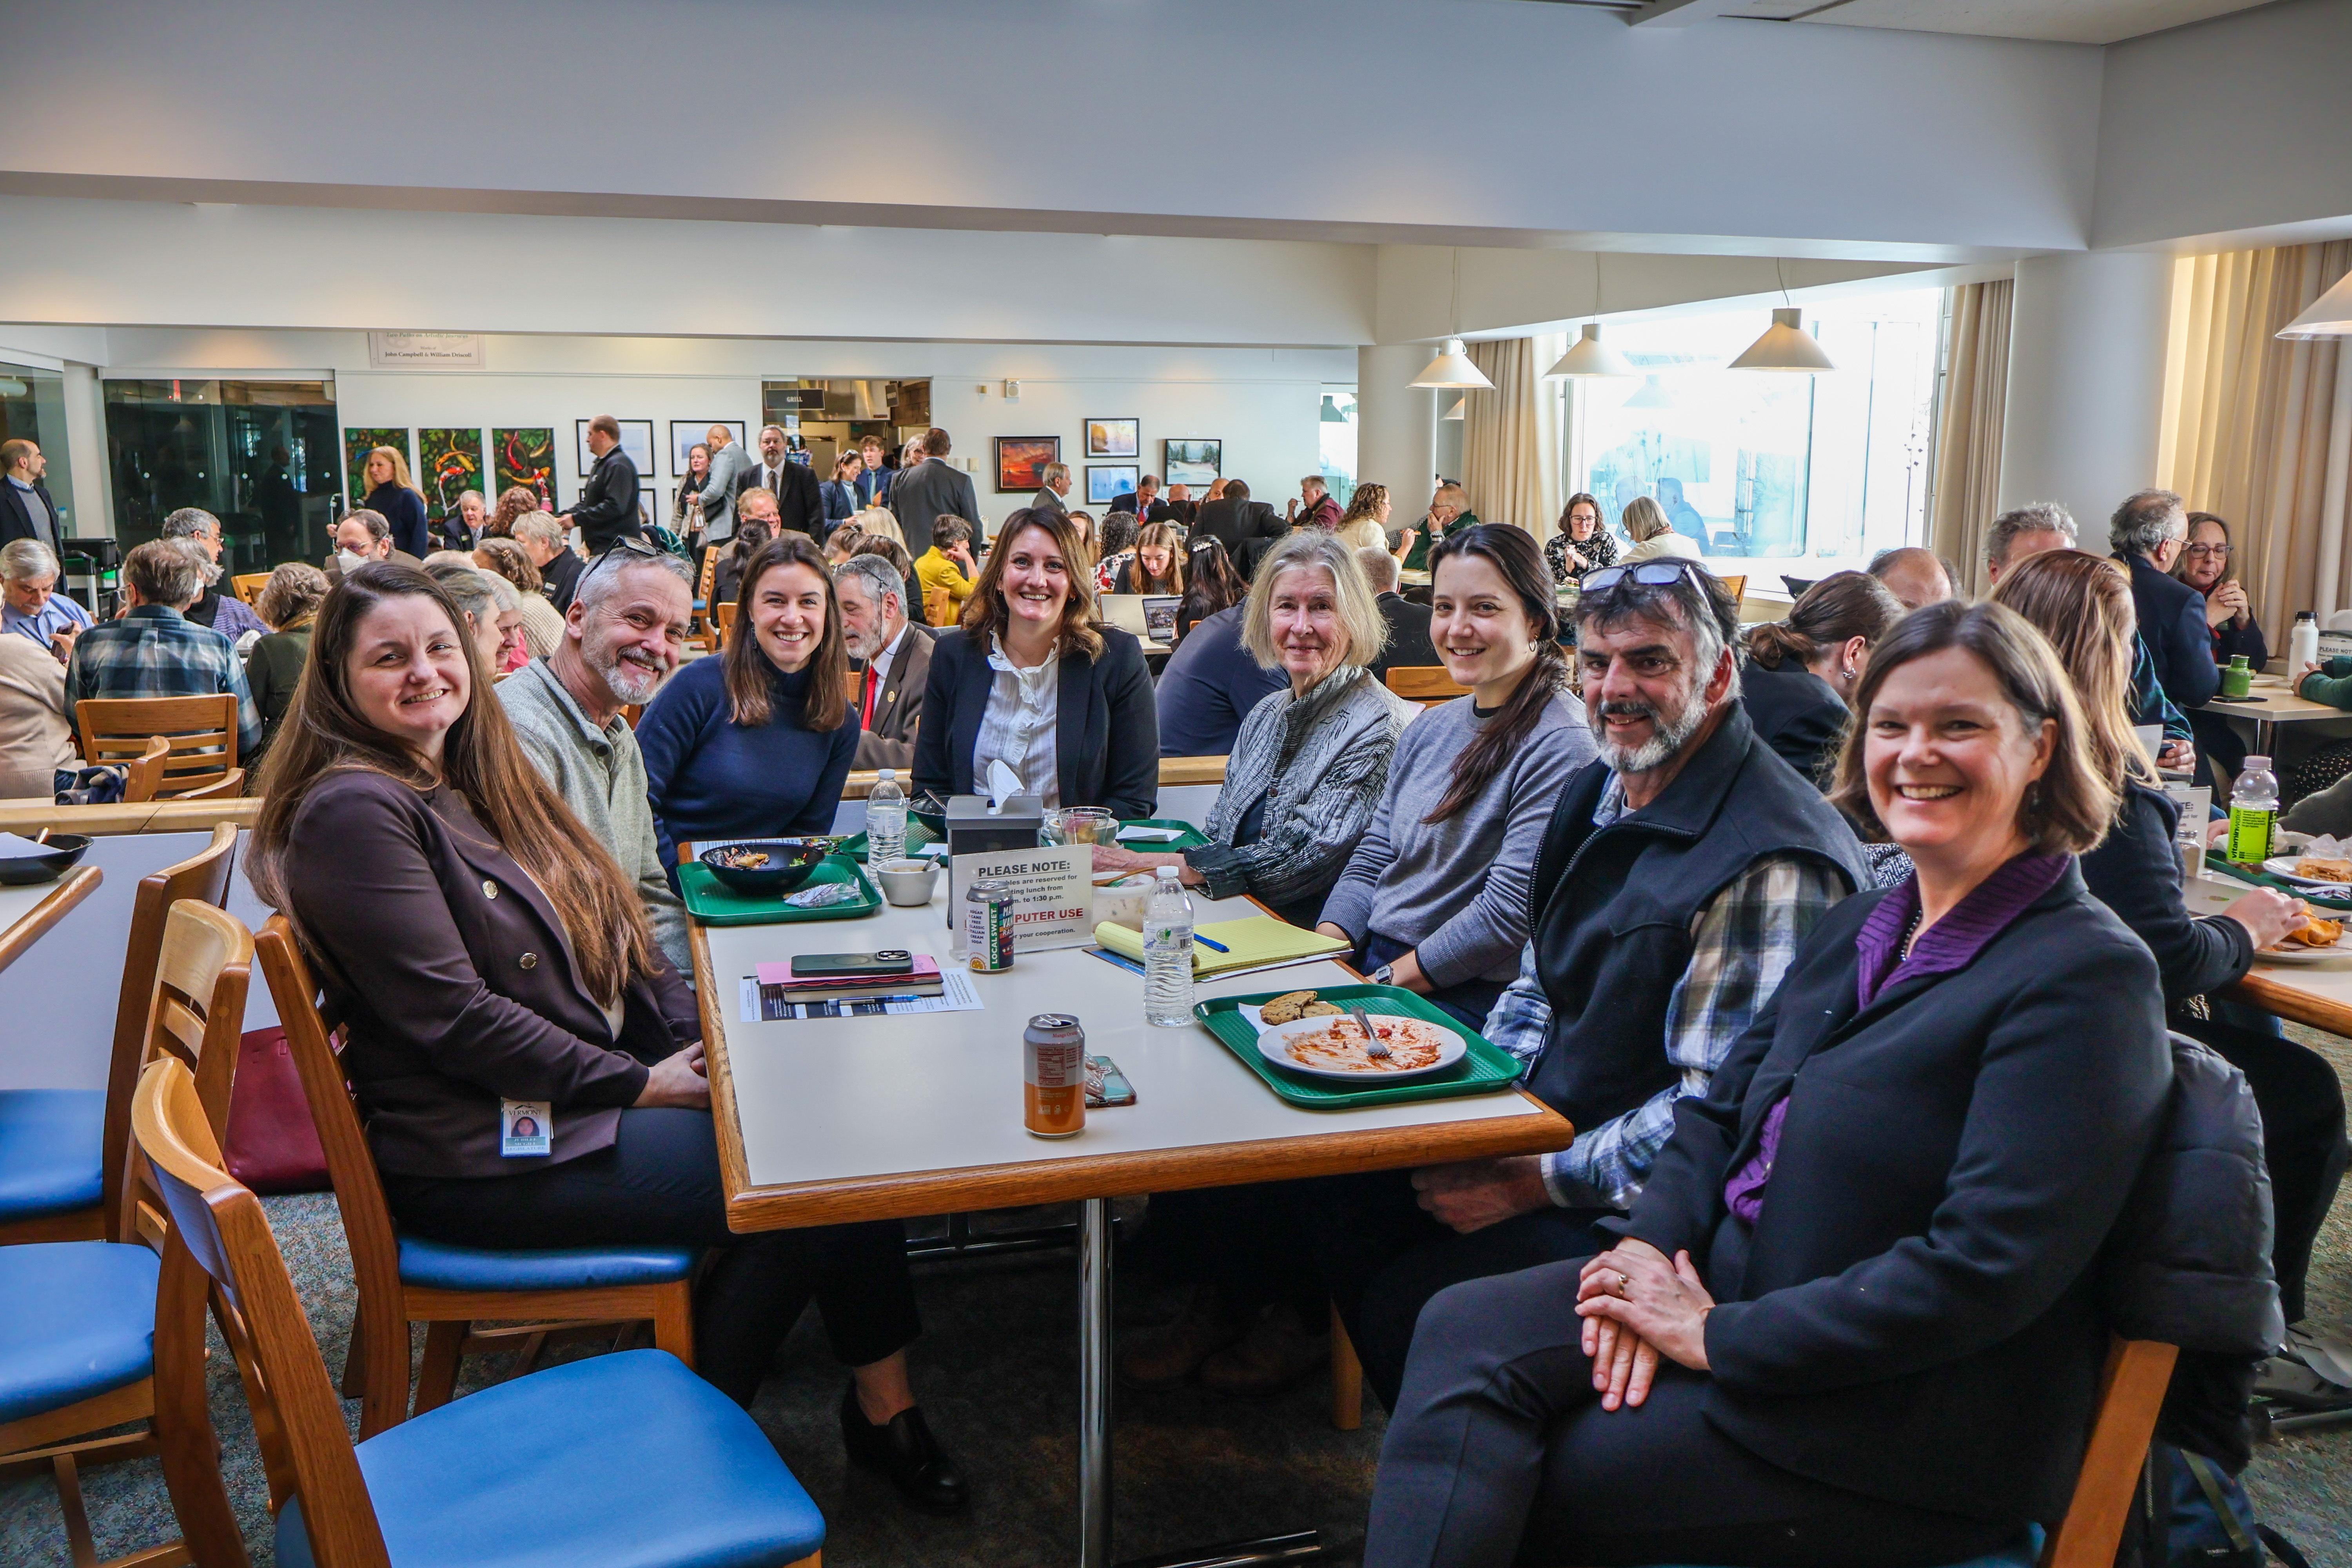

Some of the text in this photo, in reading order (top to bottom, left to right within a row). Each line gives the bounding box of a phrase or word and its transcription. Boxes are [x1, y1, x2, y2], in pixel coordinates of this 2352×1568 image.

[2231, 809, 2241, 858] vitaminwater
[978, 860, 1071, 877] PLEASE NOTE:
[1036, 875, 1066, 883] reserved
[1014, 908, 1083, 923] PUTER USE
[1035, 928, 1076, 937] cooperation.
